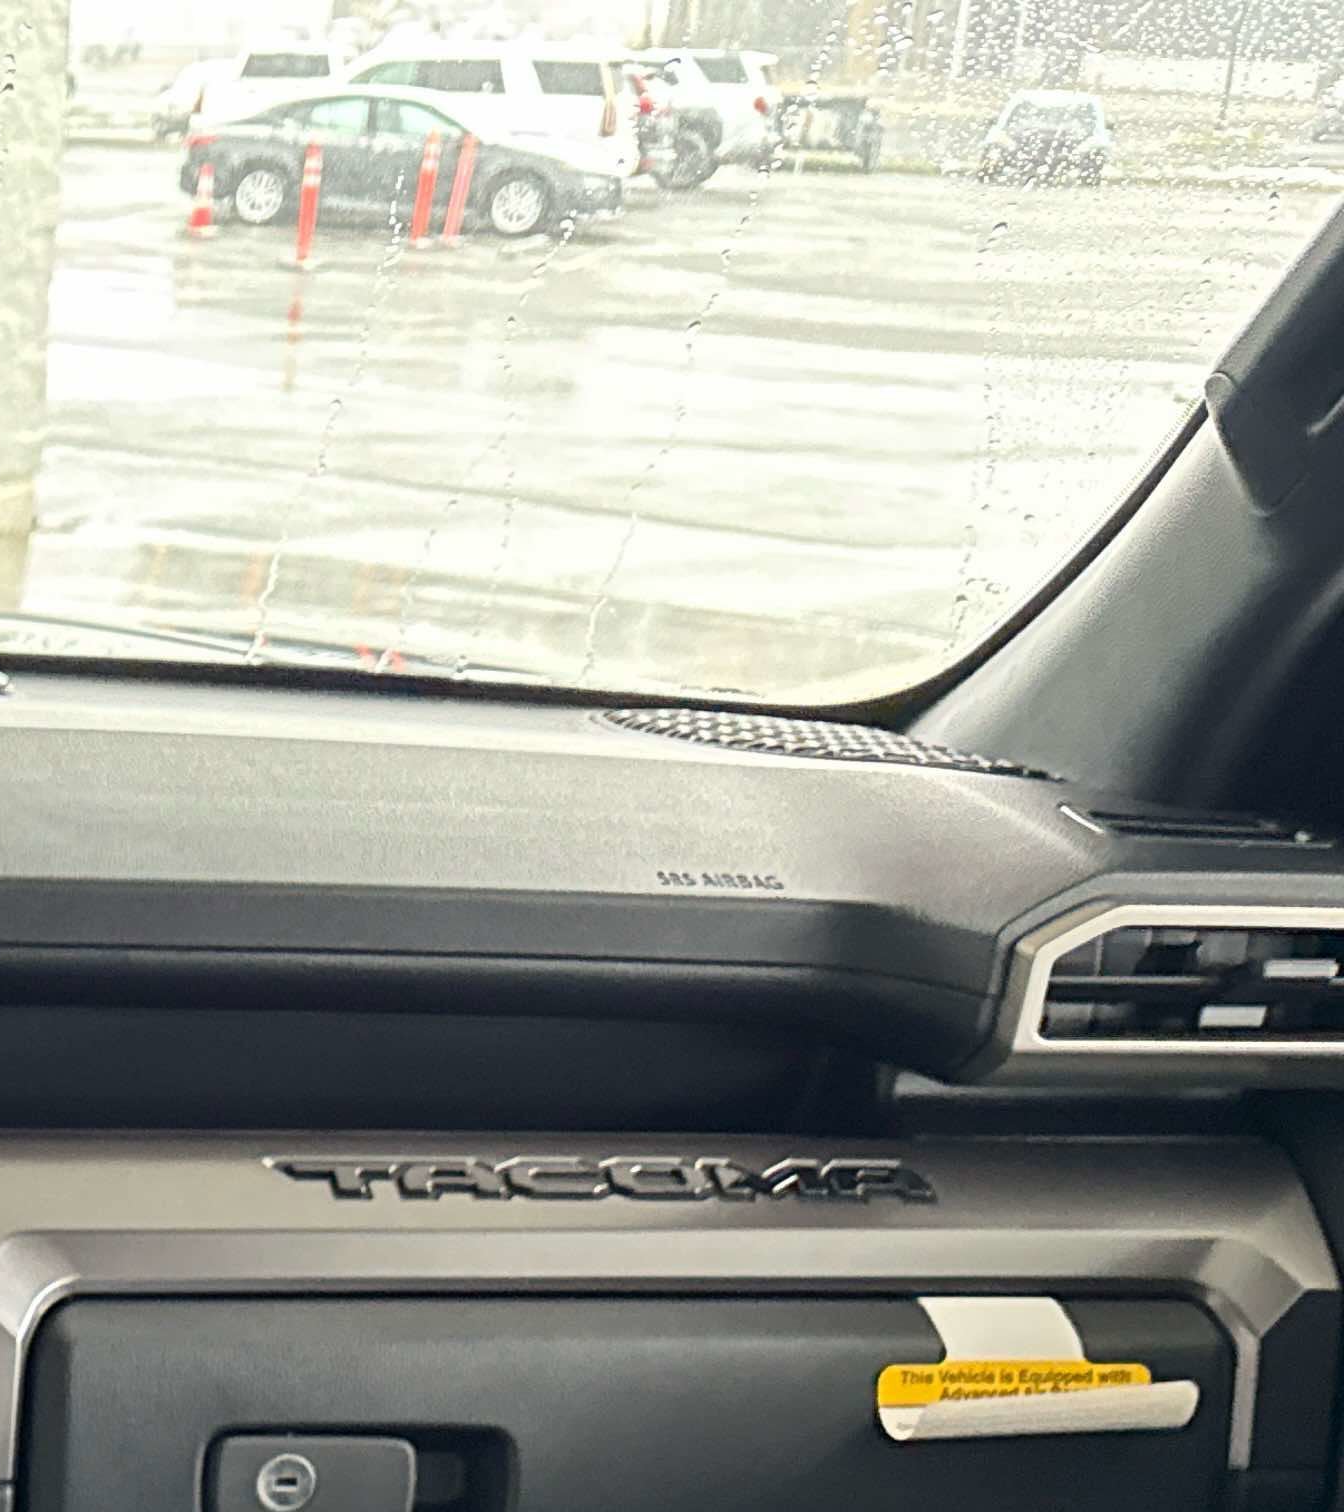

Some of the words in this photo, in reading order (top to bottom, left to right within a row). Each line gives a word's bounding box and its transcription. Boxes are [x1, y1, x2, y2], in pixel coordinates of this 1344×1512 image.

[657, 871, 696, 886] SRS
[702, 872, 784, 890] AIRBAG
[262, 1155, 938, 1204] TACOMA
[900, 1370, 933, 1386] This
[938, 1370, 996, 1385] Vehicle
[999, 1369, 1012, 1385] is
[1018, 1369, 1093, 1388] Equipped
[1097, 1369, 1132, 1385] with
